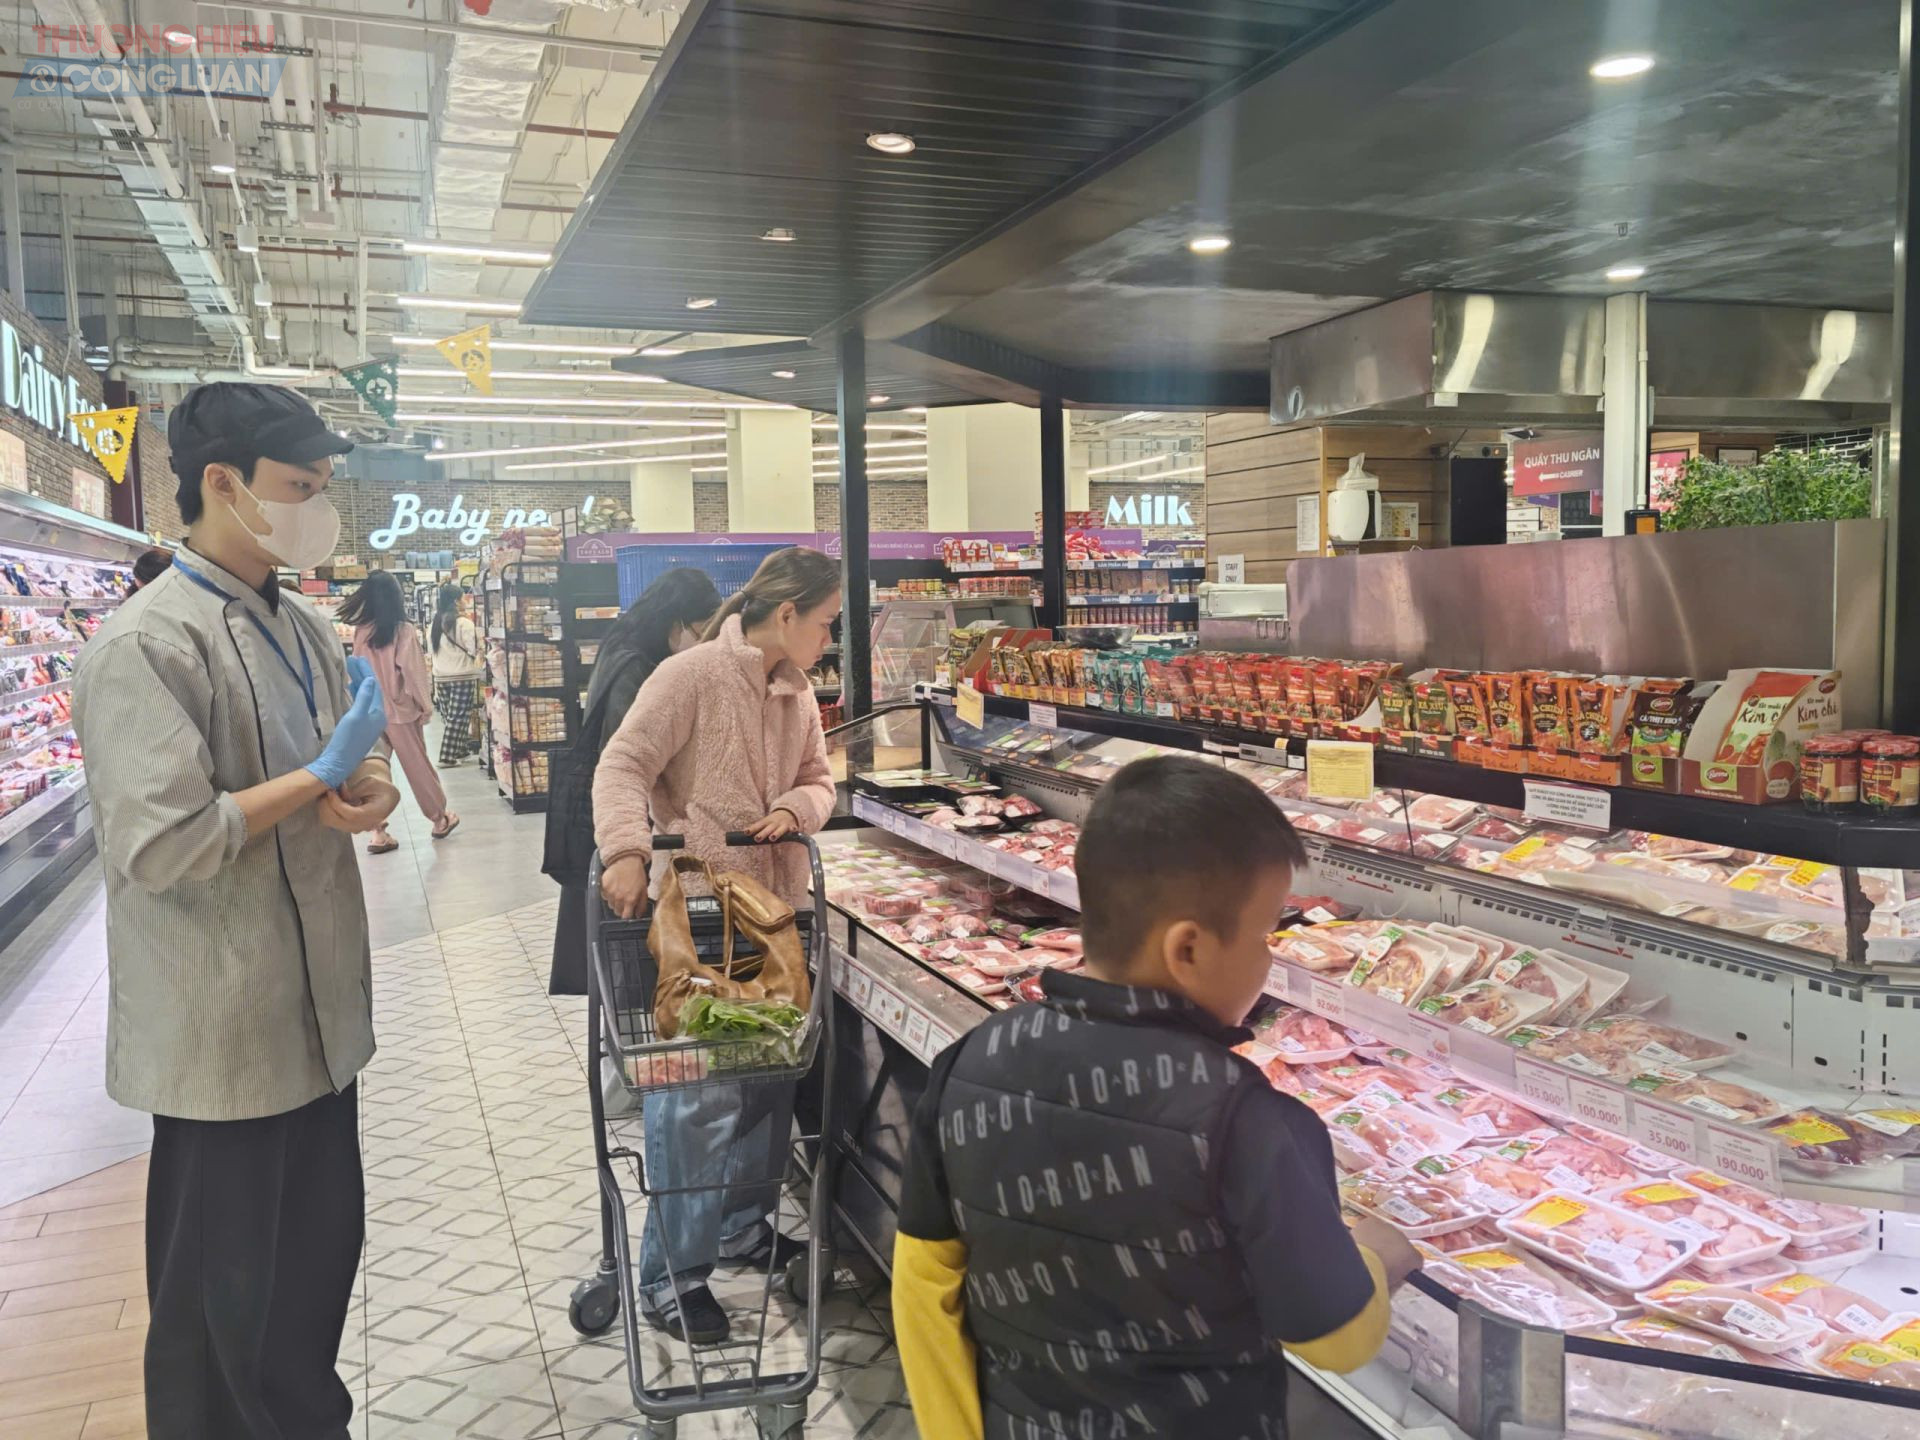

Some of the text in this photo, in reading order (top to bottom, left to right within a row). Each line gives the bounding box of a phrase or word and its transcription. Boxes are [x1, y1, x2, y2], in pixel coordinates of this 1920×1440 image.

[2, 320, 66, 439] Dairy
[1551, 452, 1570, 465] THU
[369, 494, 490, 549] Baby
[1105, 494, 1194, 526] Milk
[1738, 708, 1767, 724] Kim
[1797, 706, 1818, 723] Kim
[1821, 698, 1838, 716] chi
[997, 1145, 1152, 1217] JORDAN
